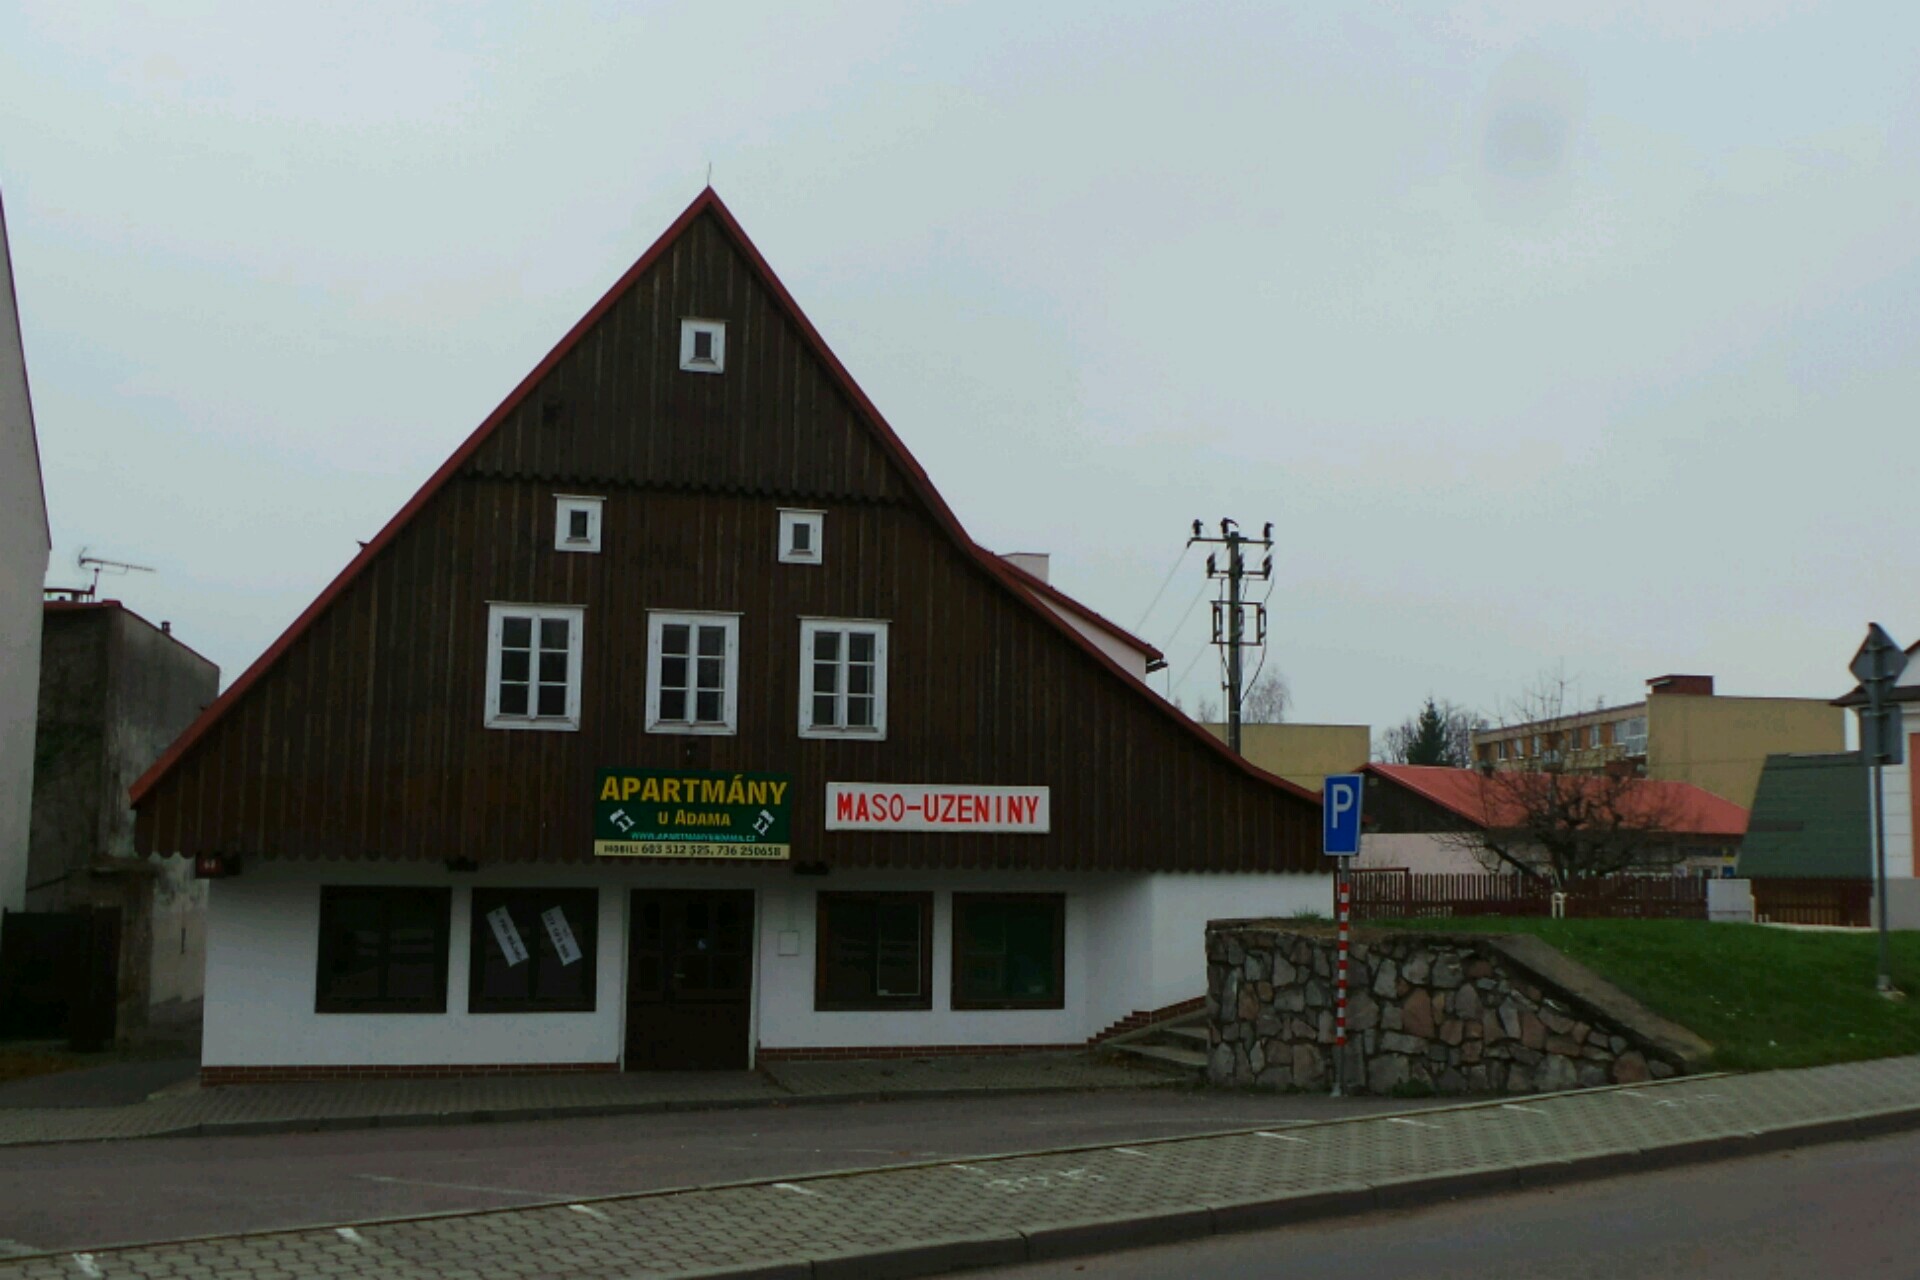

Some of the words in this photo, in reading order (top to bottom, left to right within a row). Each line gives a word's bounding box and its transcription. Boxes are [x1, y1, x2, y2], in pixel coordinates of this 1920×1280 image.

[600, 774, 788, 805] APARTMÁNY
[836, 792, 1039, 824] MASO-UZENINY
[1332, 784, 1353, 828] P
[641, 844, 662, 854] 603
[665, 845, 686, 855] 512
[716, 845, 737, 856] 736
